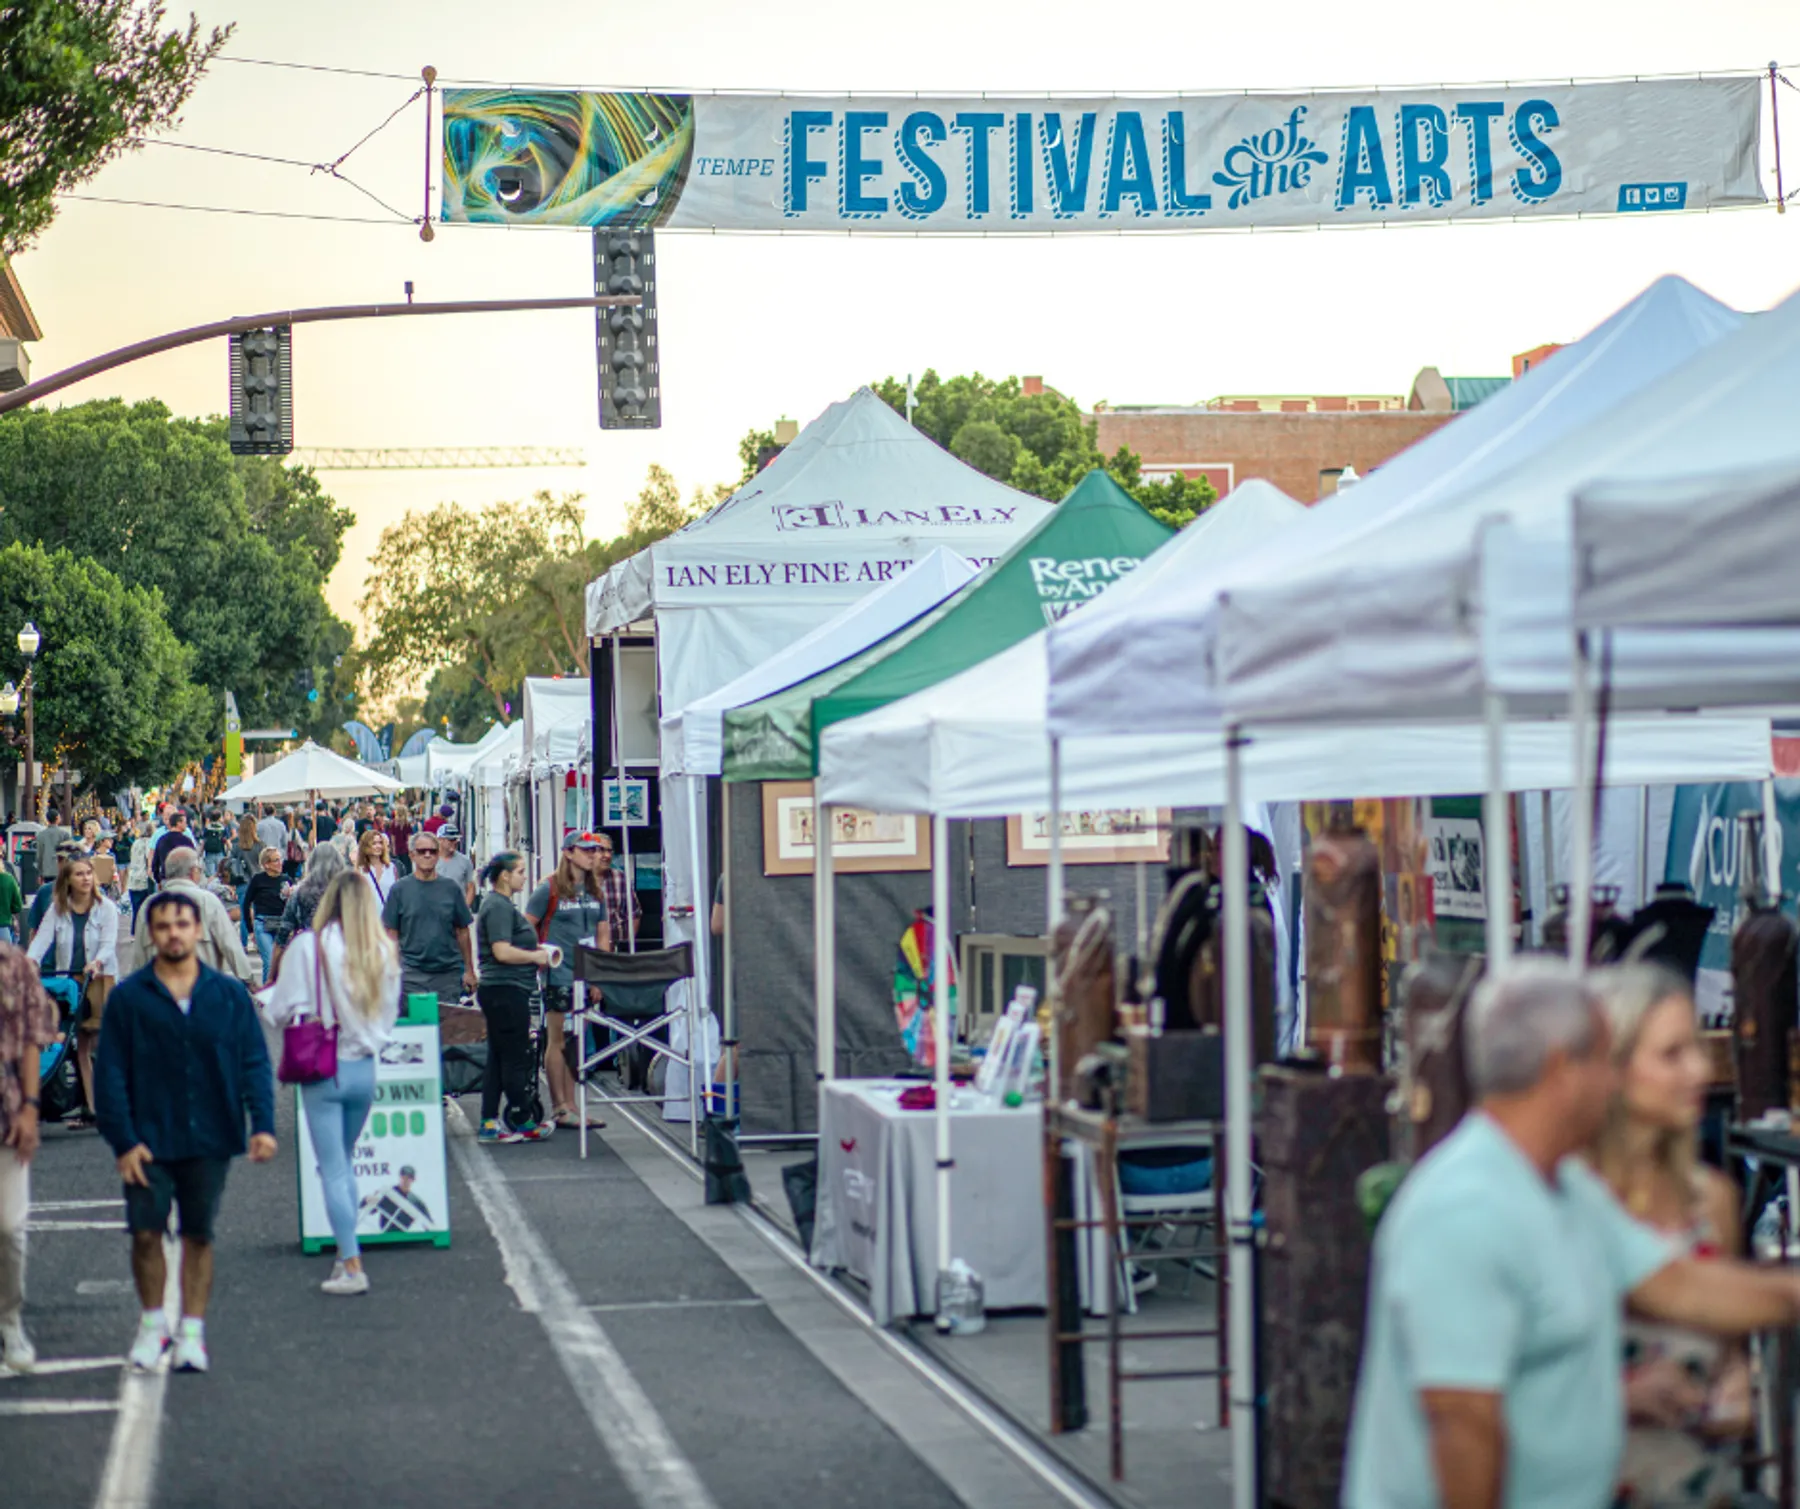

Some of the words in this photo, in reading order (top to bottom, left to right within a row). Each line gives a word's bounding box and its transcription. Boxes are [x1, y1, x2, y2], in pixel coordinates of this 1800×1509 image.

[1260, 105, 1309, 158] of
[697, 157, 775, 176] TEMPE
[784, 110, 1212, 219] FESTIVAL
[1334, 99, 1562, 211] ARTS
[1238, 152, 1311, 200] the
[666, 565, 718, 587] IAN
[725, 563, 778, 585] ELY
[783, 561, 851, 584] FINE
[1036, 582, 1065, 599] by
[389, 1083, 425, 1101] WIN!
[352, 1146, 375, 1160] OW
